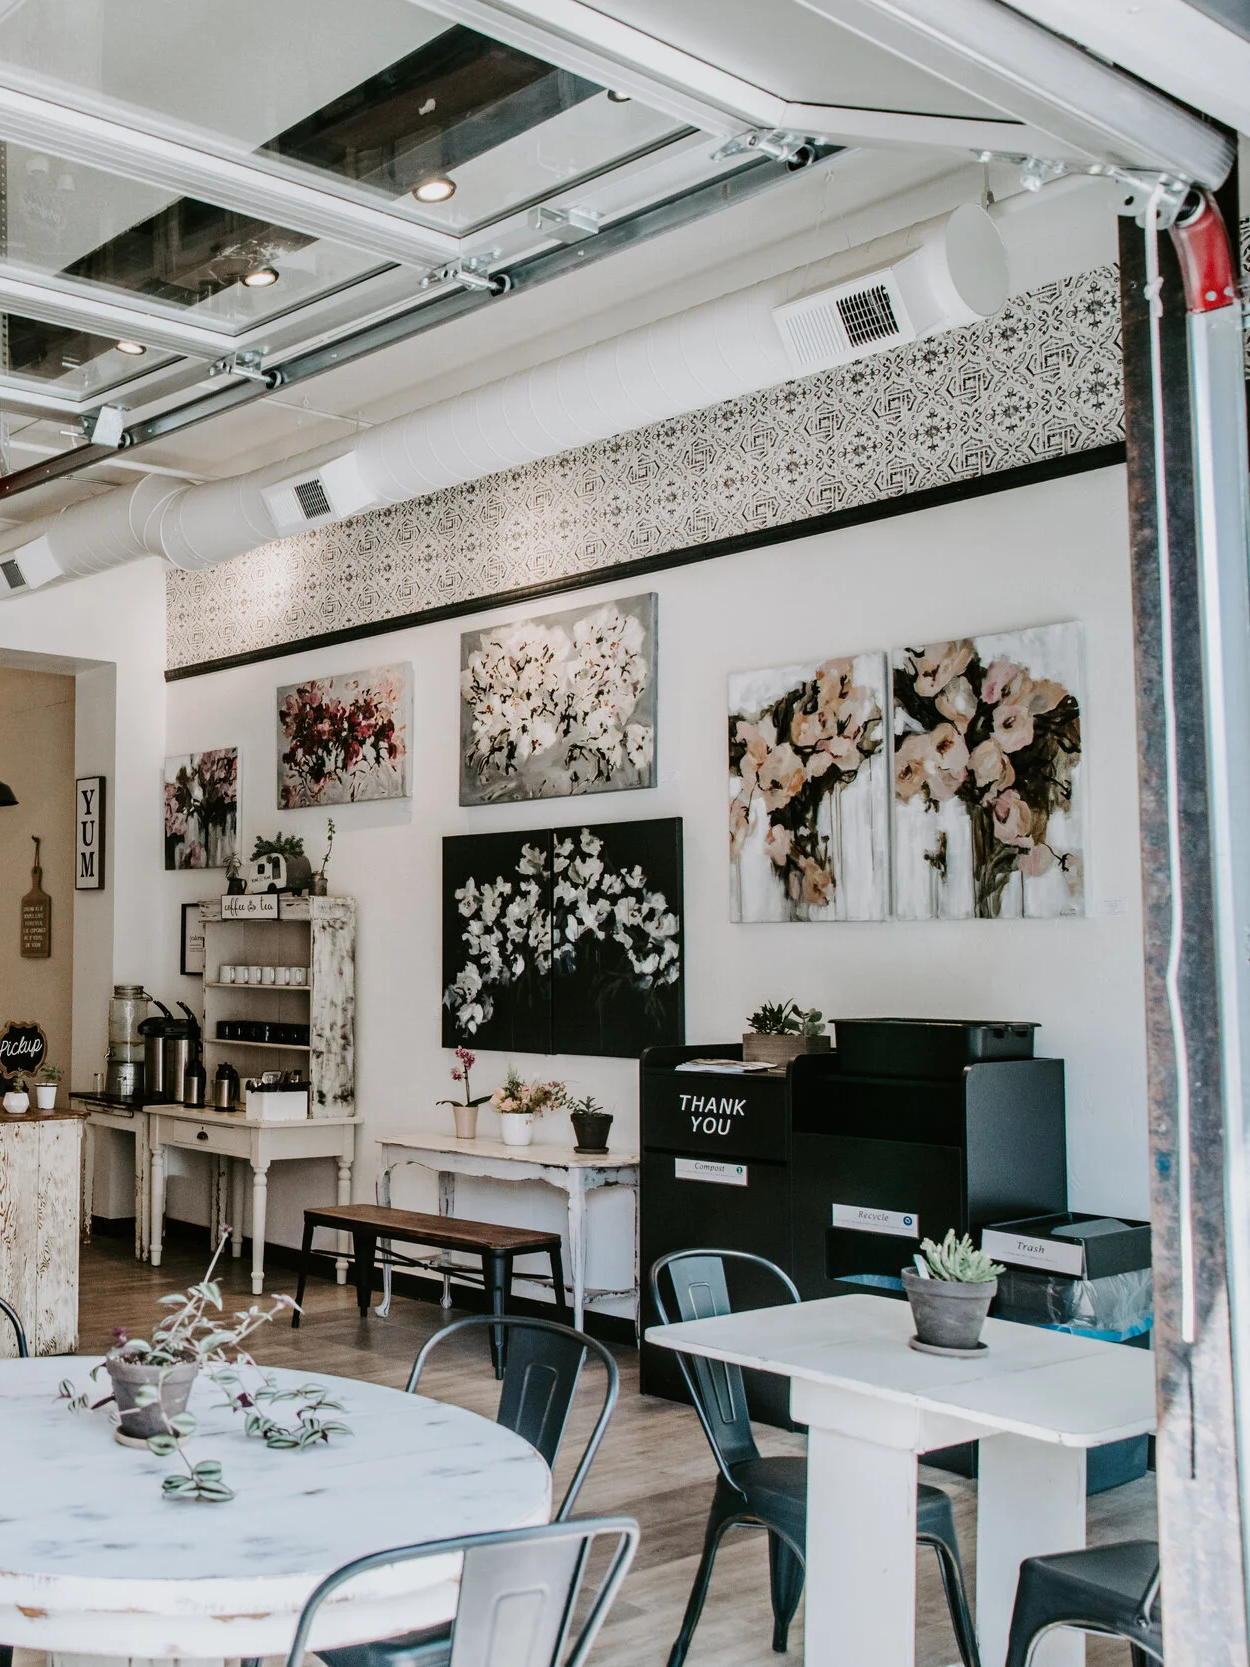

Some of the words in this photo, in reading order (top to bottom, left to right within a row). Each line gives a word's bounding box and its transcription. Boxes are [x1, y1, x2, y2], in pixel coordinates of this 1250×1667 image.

[80, 789, 95, 878] YUM
[224, 897, 246, 917] coffee
[260, 895, 274, 911] tea
[0, 1036, 43, 1058] Pickup
[679, 1094, 747, 1116] THANK
[691, 1115, 731, 1136] YOU
[694, 1162, 725, 1173] Compost
[858, 1211, 889, 1222] Recycle
[1016, 1241, 1045, 1253] Trash
